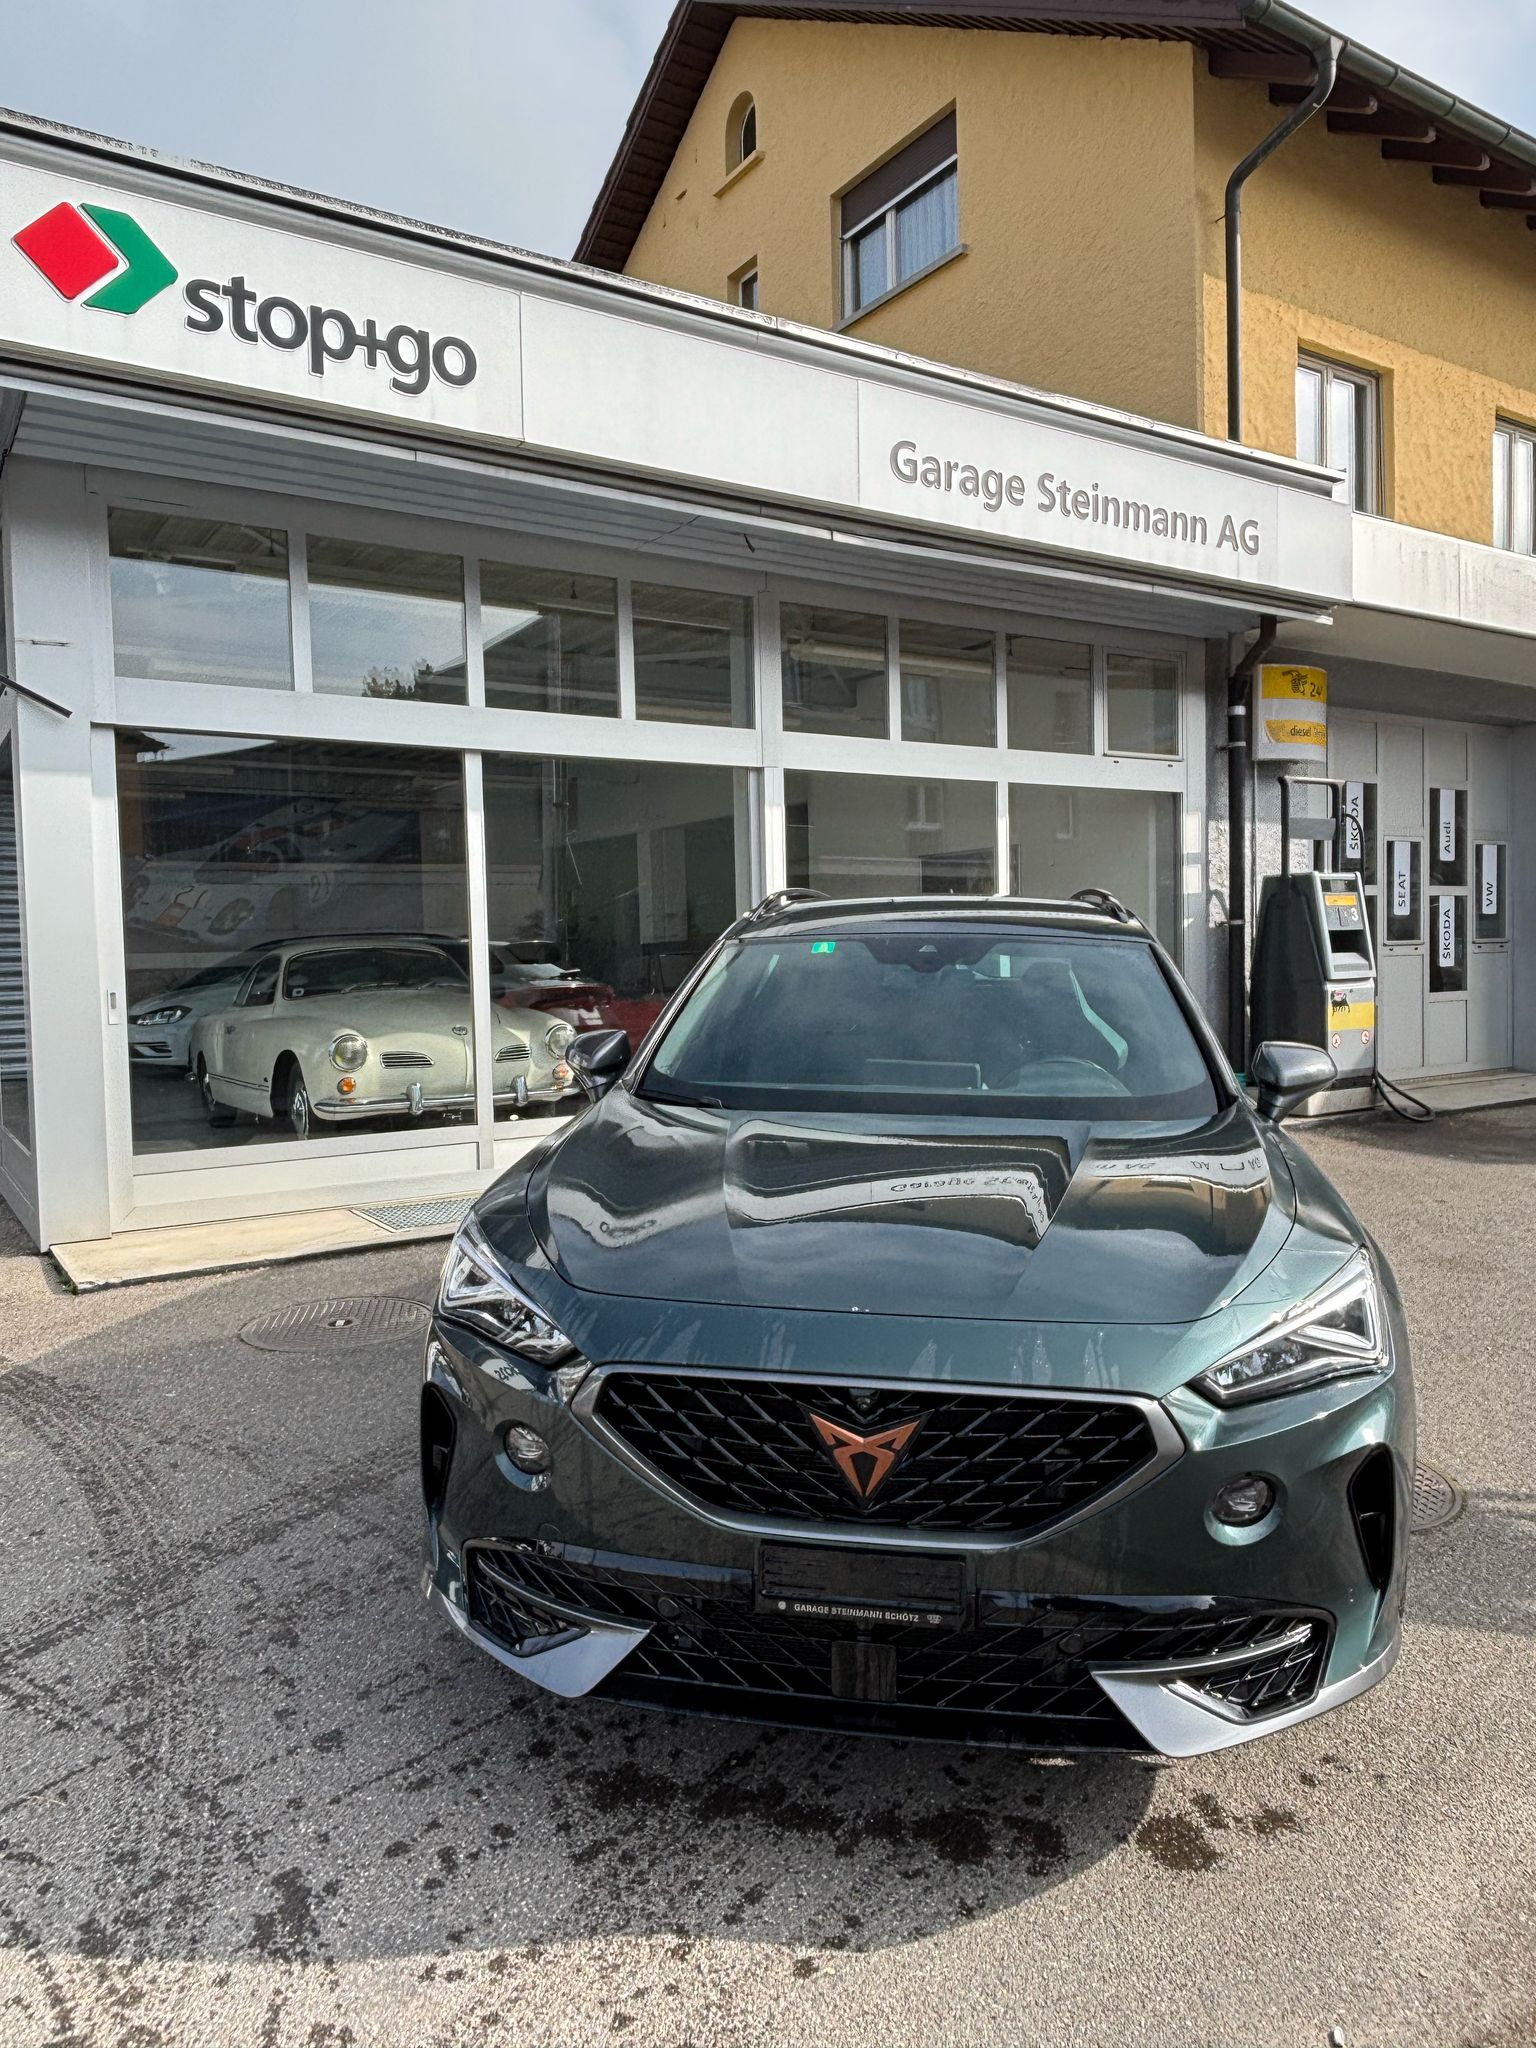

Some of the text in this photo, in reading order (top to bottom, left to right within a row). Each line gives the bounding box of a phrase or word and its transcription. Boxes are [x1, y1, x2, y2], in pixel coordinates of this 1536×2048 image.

[184, 276, 477, 395] stop+go
[889, 440, 1260, 556] Garage Steinmann AG
[1290, 725, 1312, 737] diesel
[1443, 821, 1451, 854] Audi
[1398, 871, 1406, 908] SEAT
[1486, 882, 1494, 907] VW
[1350, 907, 1359, 922] 3
[1442, 908, 1451, 960] ŠKODA
[794, 1602, 830, 1614] GARAGE
[831, 1606, 883, 1619] STEINMANN
